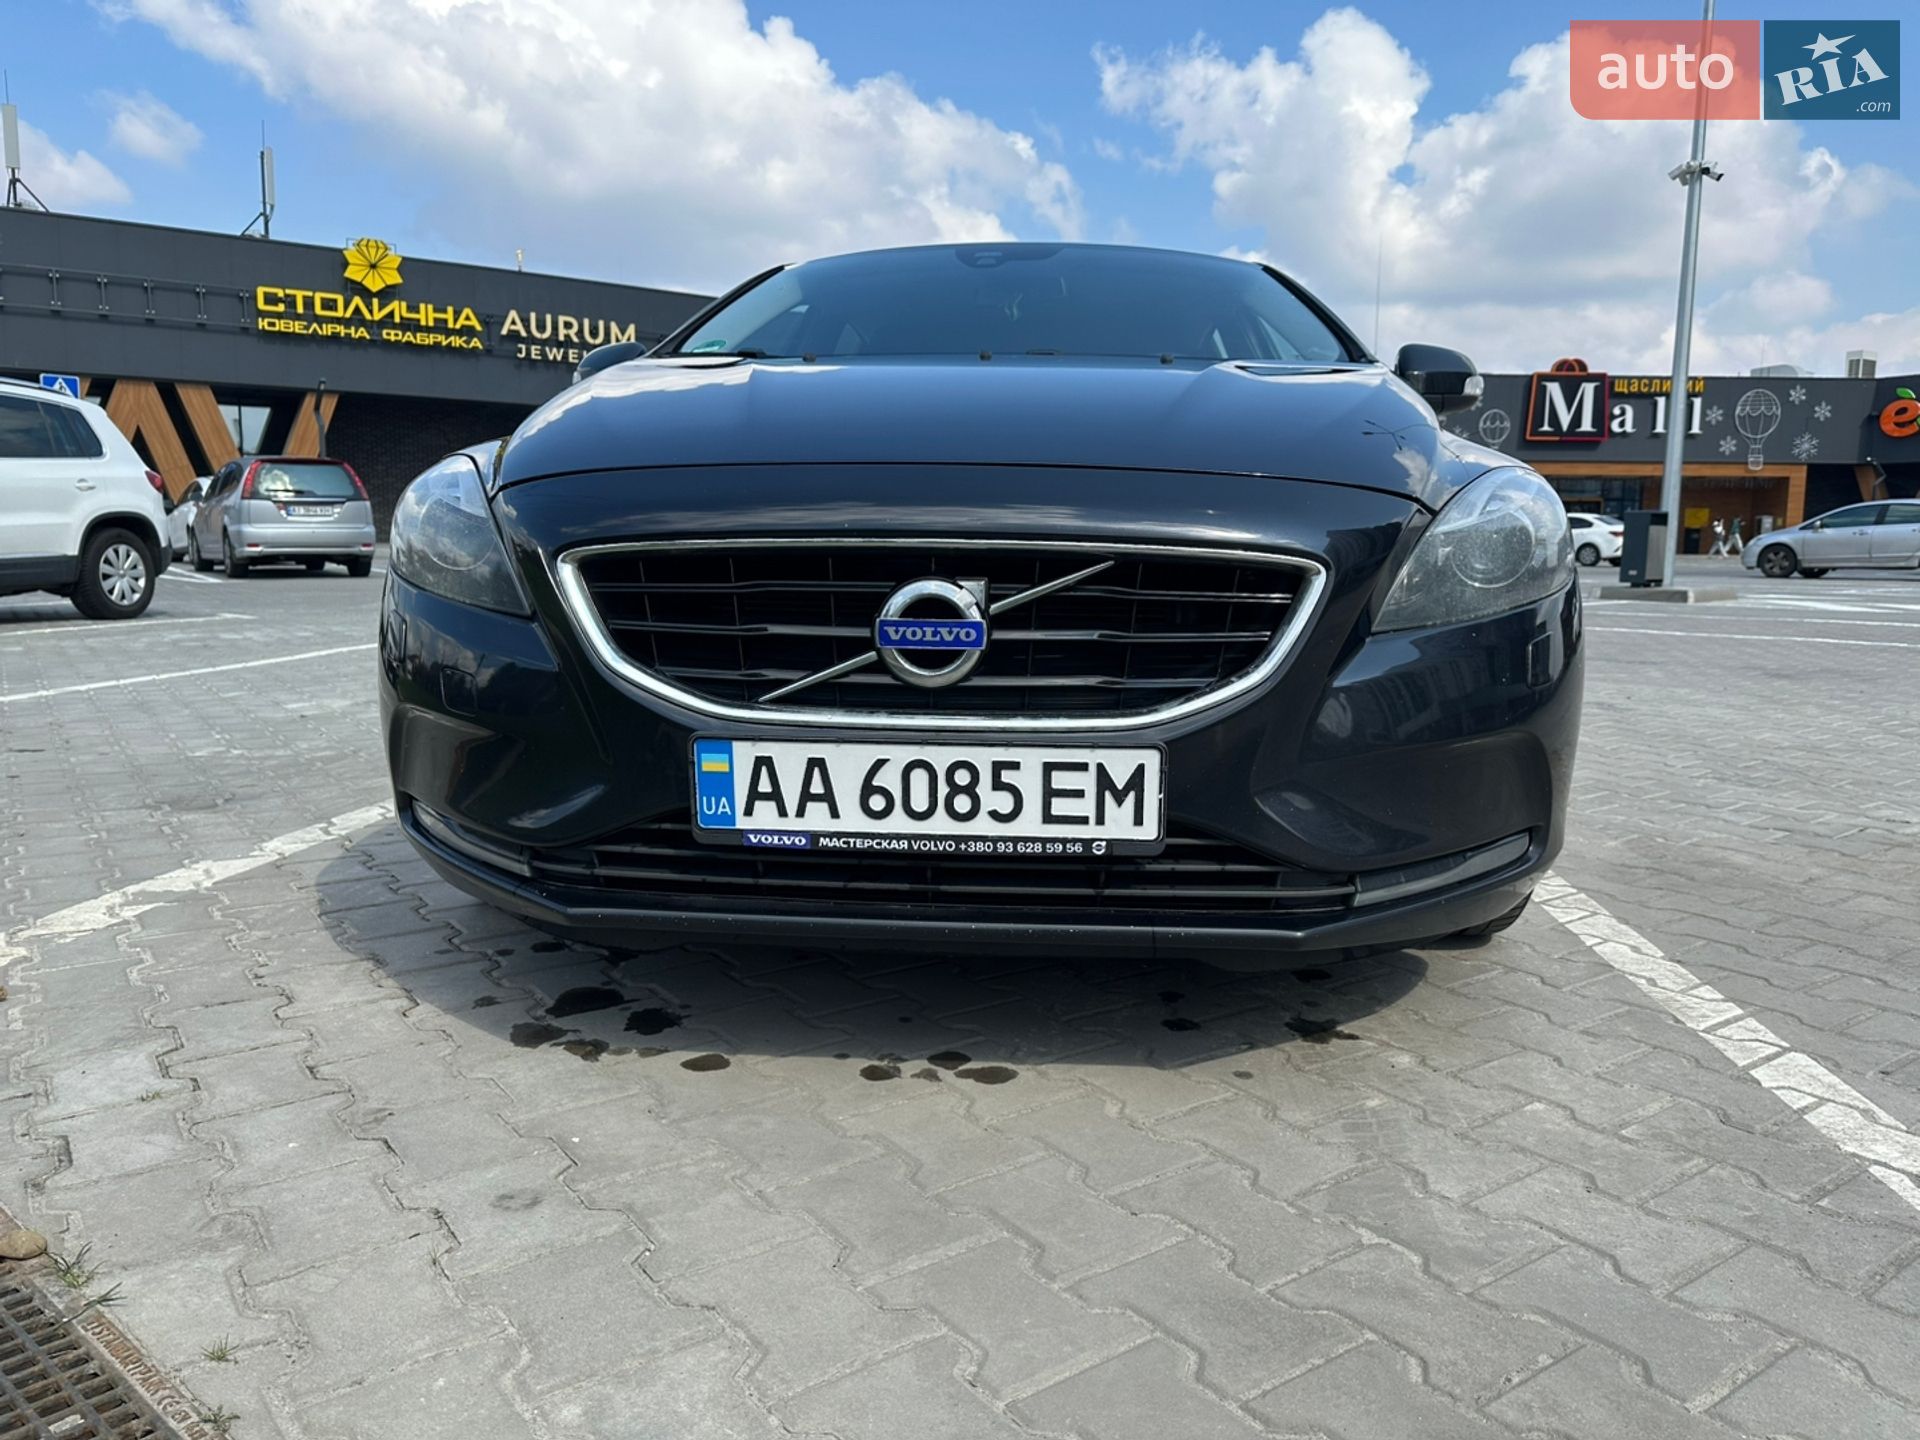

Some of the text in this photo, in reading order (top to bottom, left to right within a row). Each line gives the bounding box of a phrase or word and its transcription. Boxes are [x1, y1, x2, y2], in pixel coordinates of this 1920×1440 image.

[256, 285, 483, 331] СТОЛИЧНА
[258, 317, 484, 350] ЮВЕЛІРНА ФАБРИКА
[500, 309, 636, 345] AURUM
[1614, 377, 1705, 394] щаслиий
[1538, 381, 1704, 435] Mall
[883, 626, 977, 641] VOLVO
[743, 755, 1146, 827] AA 6085 EM
[702, 796, 731, 815] UA
[747, 834, 807, 847] VOLVO
[819, 836, 1083, 854] МАСТЕРСКАЯ VOLVO +380 93 628 59 56
